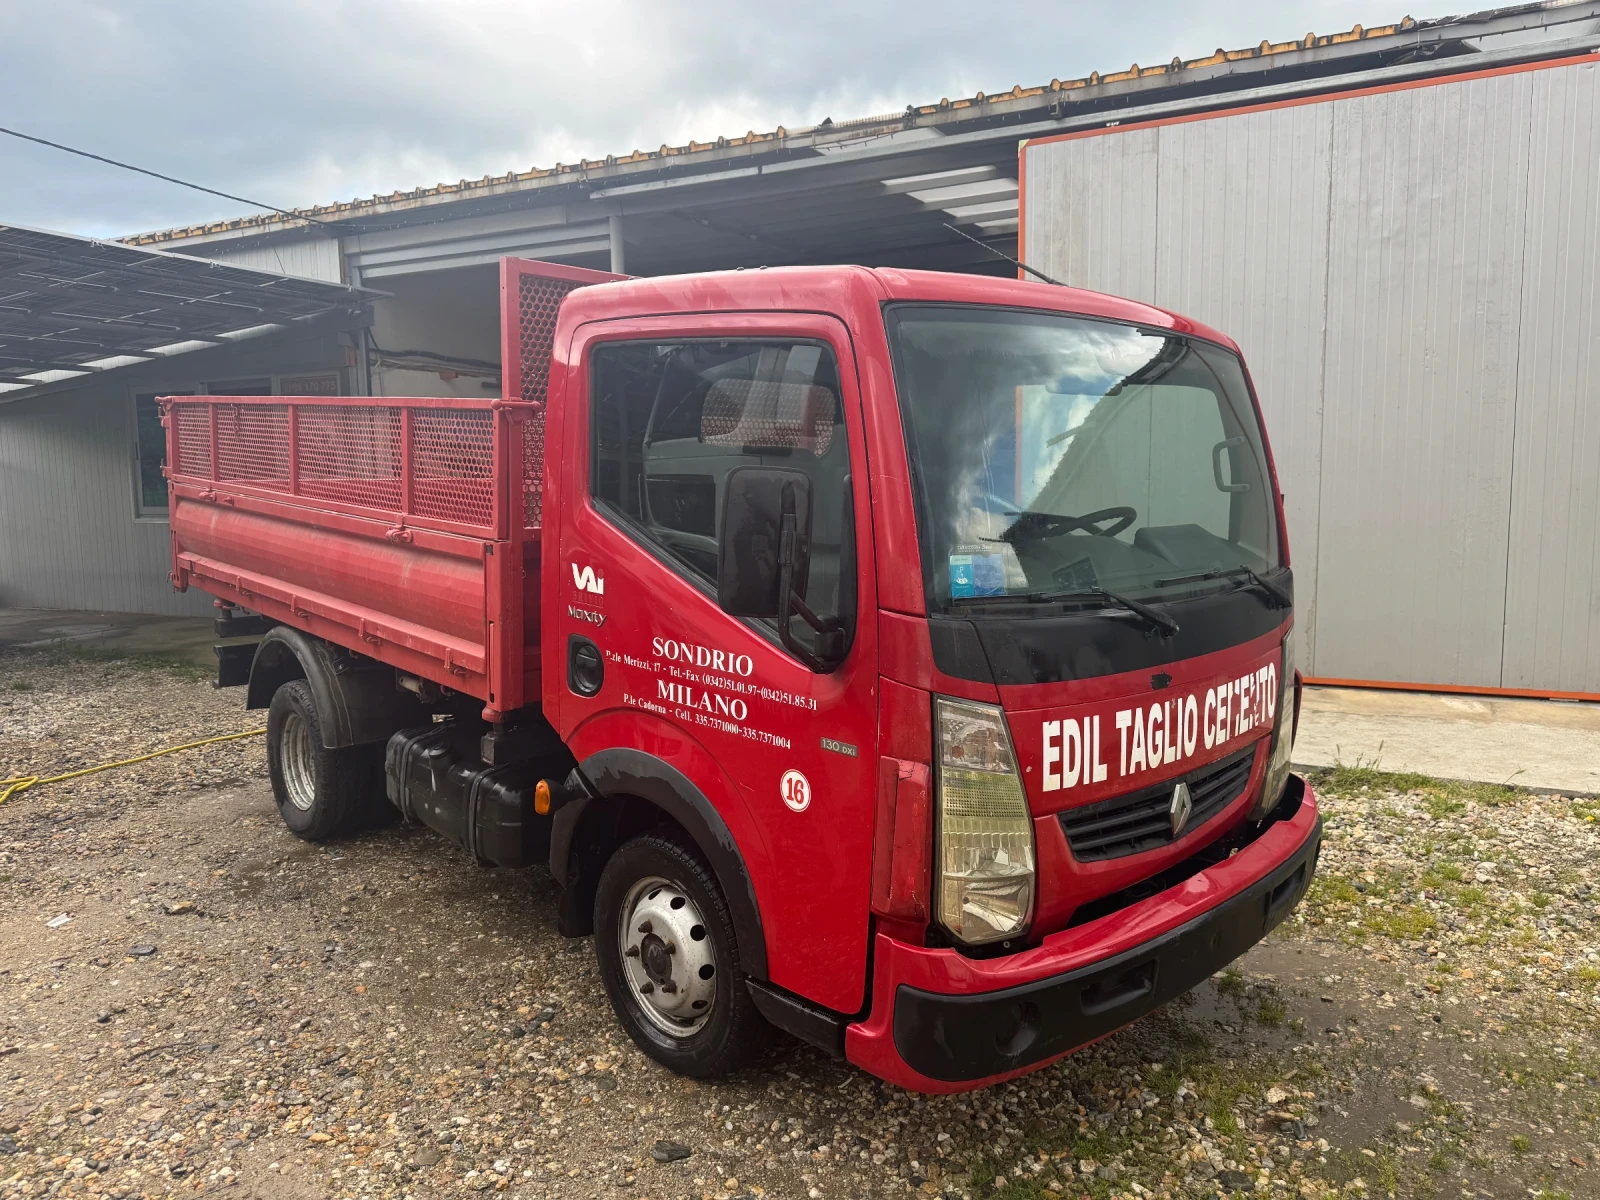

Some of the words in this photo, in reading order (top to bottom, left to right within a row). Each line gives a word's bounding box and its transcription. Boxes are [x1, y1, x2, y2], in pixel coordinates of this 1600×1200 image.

[568, 604, 607, 628] Maxity
[652, 637, 753, 677] SONDRIO
[654, 662, 661, 672] 17
[638, 697, 666, 714] Cadorna
[657, 679, 748, 721] MILANO
[822, 739, 840, 752] 130
[1042, 715, 1107, 792] EDIL
[1115, 694, 1198, 777] TAGLIO
[786, 777, 805, 805] 16
